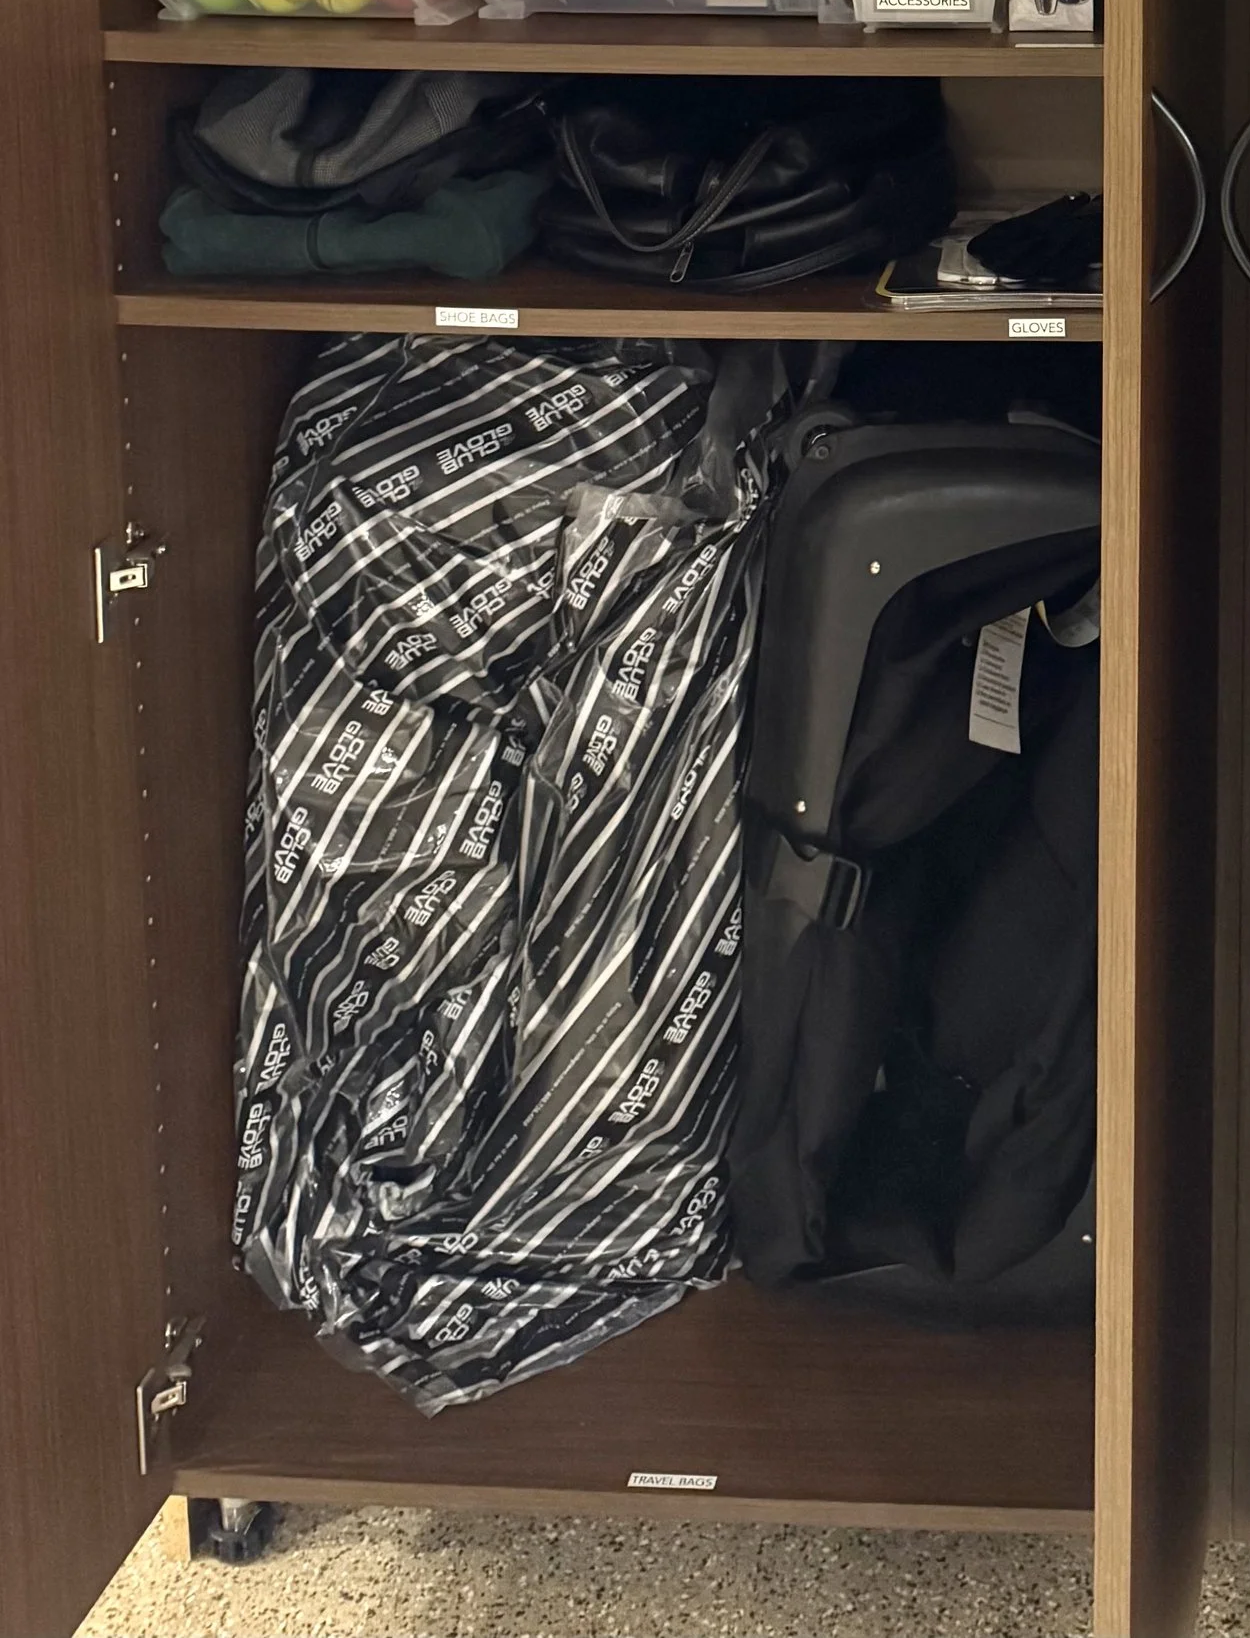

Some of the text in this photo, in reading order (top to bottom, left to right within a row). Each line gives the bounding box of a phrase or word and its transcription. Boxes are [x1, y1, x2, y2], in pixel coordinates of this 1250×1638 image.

[439, 310, 516, 324] SHOE BAGS
[1011, 321, 1064, 334] GLOVES
[525, 384, 587, 425] GLOVE
[534, 398, 584, 432] CLUB
[436, 423, 513, 464] GLOVE
[443, 439, 501, 475] CLUB
[295, 522, 337, 561] CLUB
[450, 578, 512, 627] GLOVE
[572, 555, 609, 610] CLUB
[662, 544, 717, 613] GLOVE
[456, 597, 506, 639] CLUB
[611, 627, 658, 697] GLOVE
[311, 720, 362, 790] GLOVE
[323, 737, 365, 795] CLUB
[459, 780, 502, 857] GLOVE
[276, 829, 312, 884] CLUB
[663, 970, 711, 1043] GLOVE
[237, 1103, 264, 1170] GLOVE
[632, 1475, 715, 1487] TRAVEL BAGS
